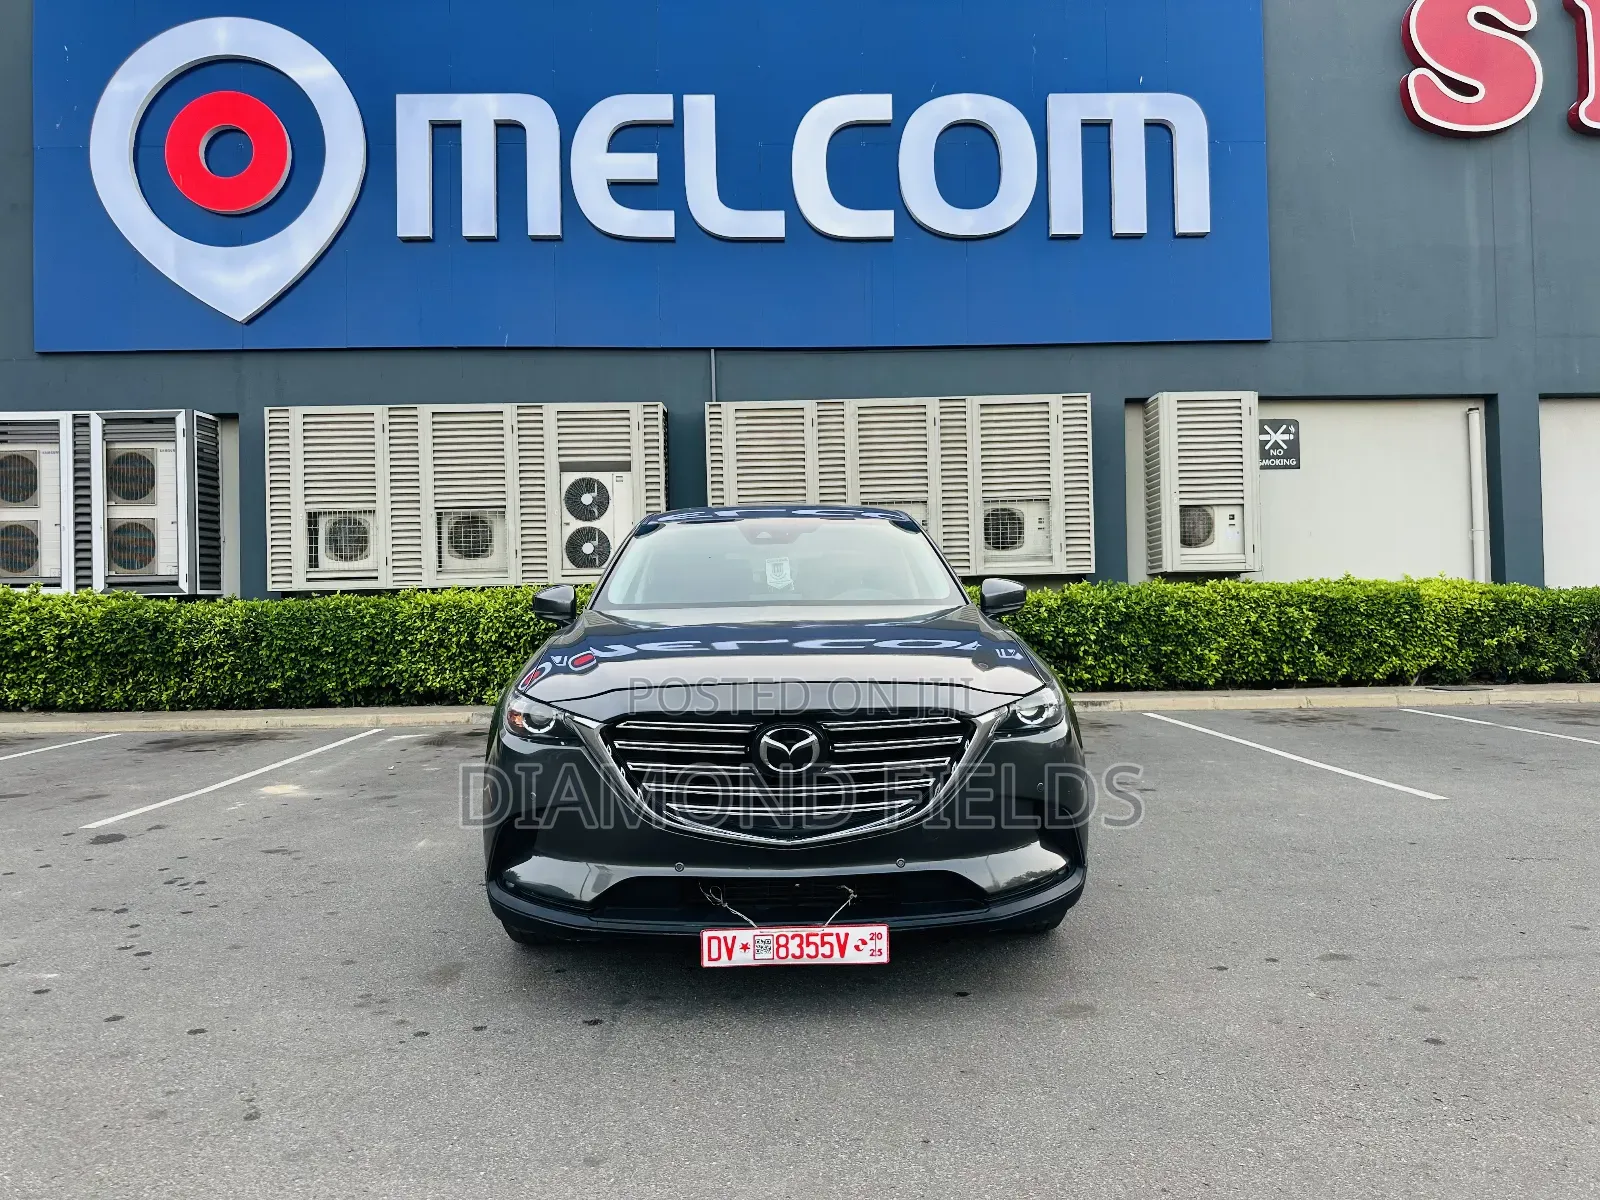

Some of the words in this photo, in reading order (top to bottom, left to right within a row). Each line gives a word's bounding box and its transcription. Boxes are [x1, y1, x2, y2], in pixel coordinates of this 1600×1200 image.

[1400, 0, 1600, 138] S
[396, 92, 1211, 241] MELCOM
[1269, 448, 1284, 456] NO
[707, 935, 737, 961] DV
[775, 932, 850, 960] 8355V
